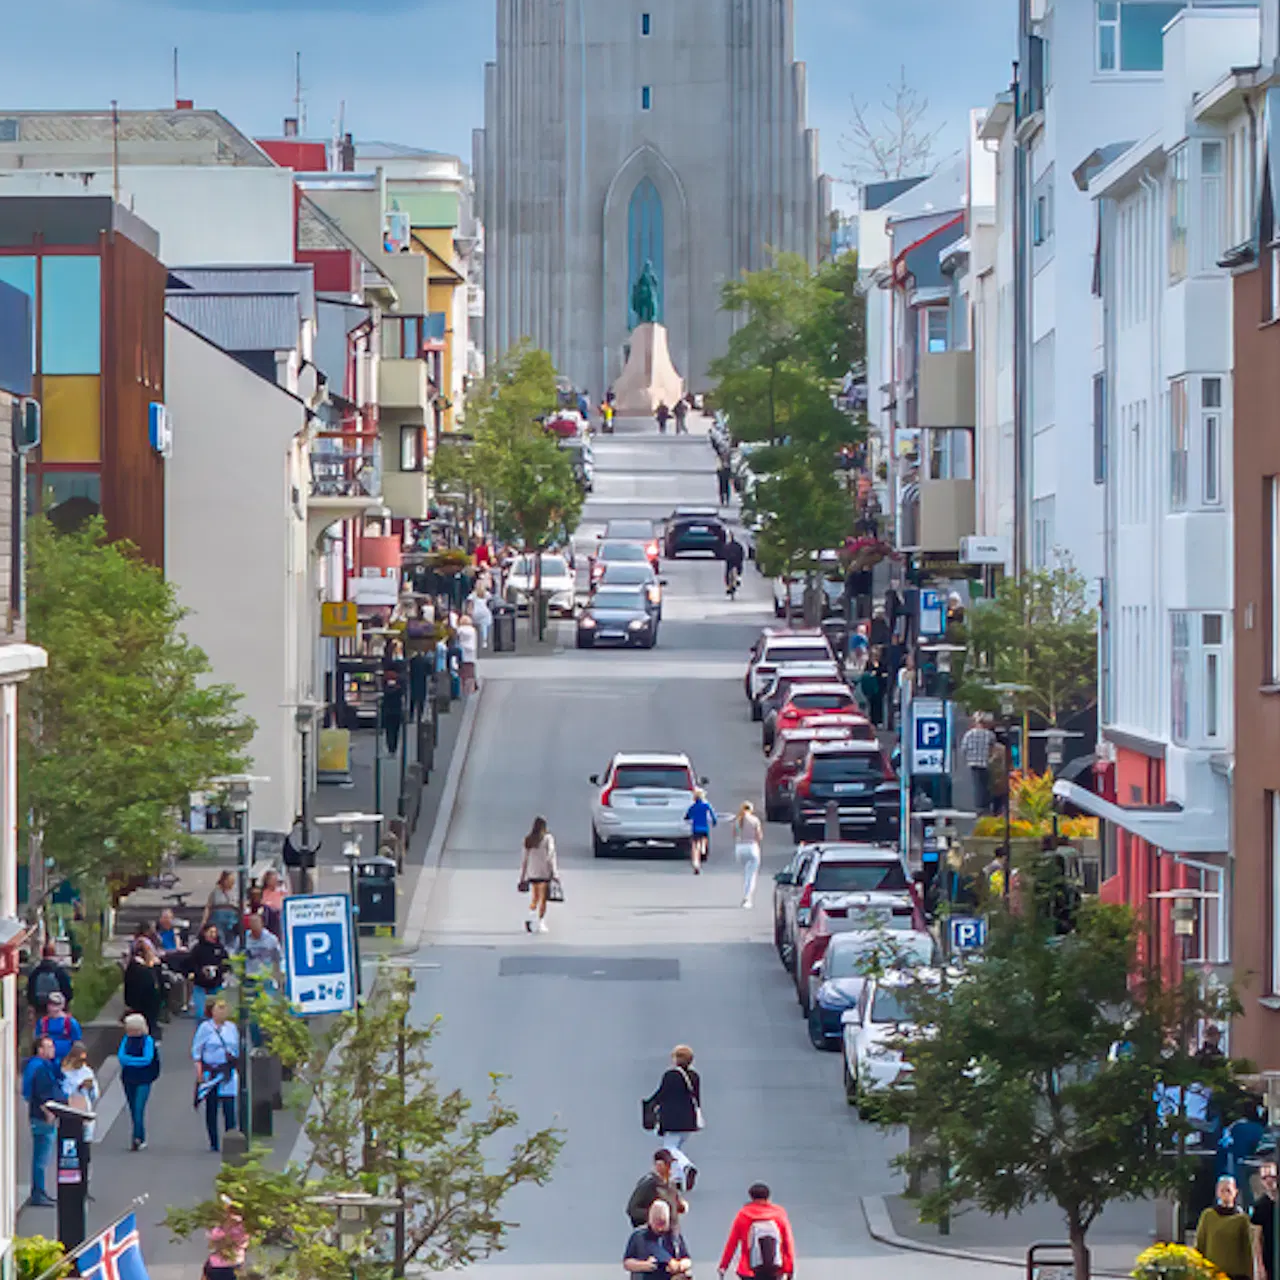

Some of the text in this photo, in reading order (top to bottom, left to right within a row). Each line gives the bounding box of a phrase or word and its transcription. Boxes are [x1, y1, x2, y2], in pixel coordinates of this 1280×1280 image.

[922, 721, 941, 745] P
[959, 924, 976, 945] P
[305, 931, 331, 968] P
